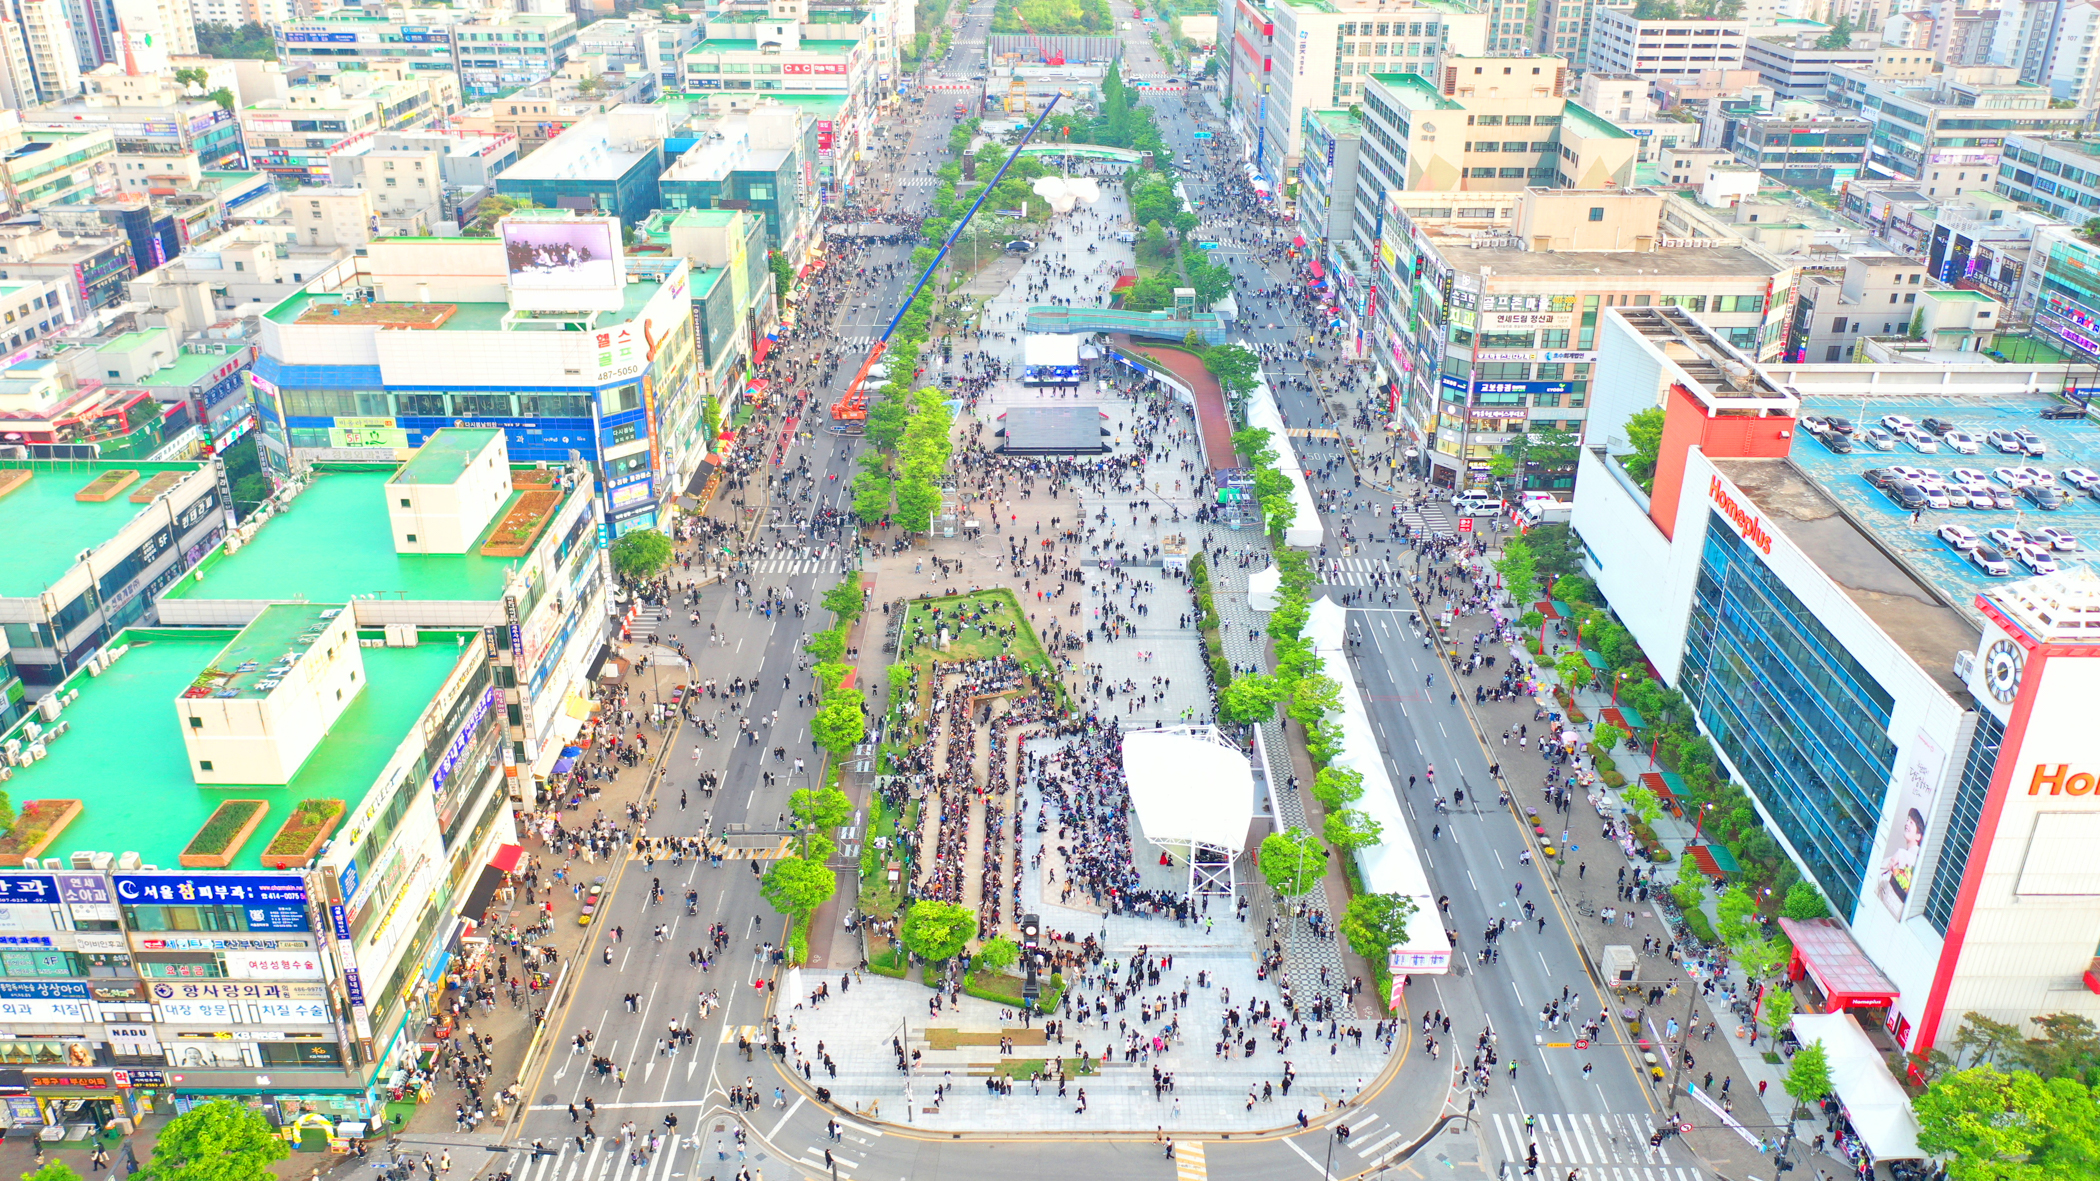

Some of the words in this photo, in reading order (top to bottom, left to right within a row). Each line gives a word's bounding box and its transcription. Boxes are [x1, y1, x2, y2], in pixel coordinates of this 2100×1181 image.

[784, 64, 792, 72] C
[803, 64, 811, 72] C
[1497, 315, 1527, 324] 연세드림
[1530, 315, 1554, 324] 정신과
[597, 365, 639, 382] 487-5050
[1307, 452, 1321, 461] 50
[1708, 474, 1772, 555] Homeplus
[159, 532, 168, 548] 5F
[2028, 764, 2100, 797] Ho
[70, 877, 95, 888] 연세
[65, 889, 108, 902] 소아과
[248, 960, 314, 970] 여성성형수술
[37, 983, 85, 996] 상상아이
[182, 984, 281, 999] 항사랑외과
[2, 1003, 33, 1016] 외과
[53, 1003, 80, 1016] 치질
[165, 1004, 191, 1016] 대장
[199, 1004, 227, 1017] 항문
[263, 1005, 290, 1017] 치질
[296, 1004, 323, 1017] 수술
[112, 1029, 147, 1037] NADU
[115, 1071, 128, 1083] 약
